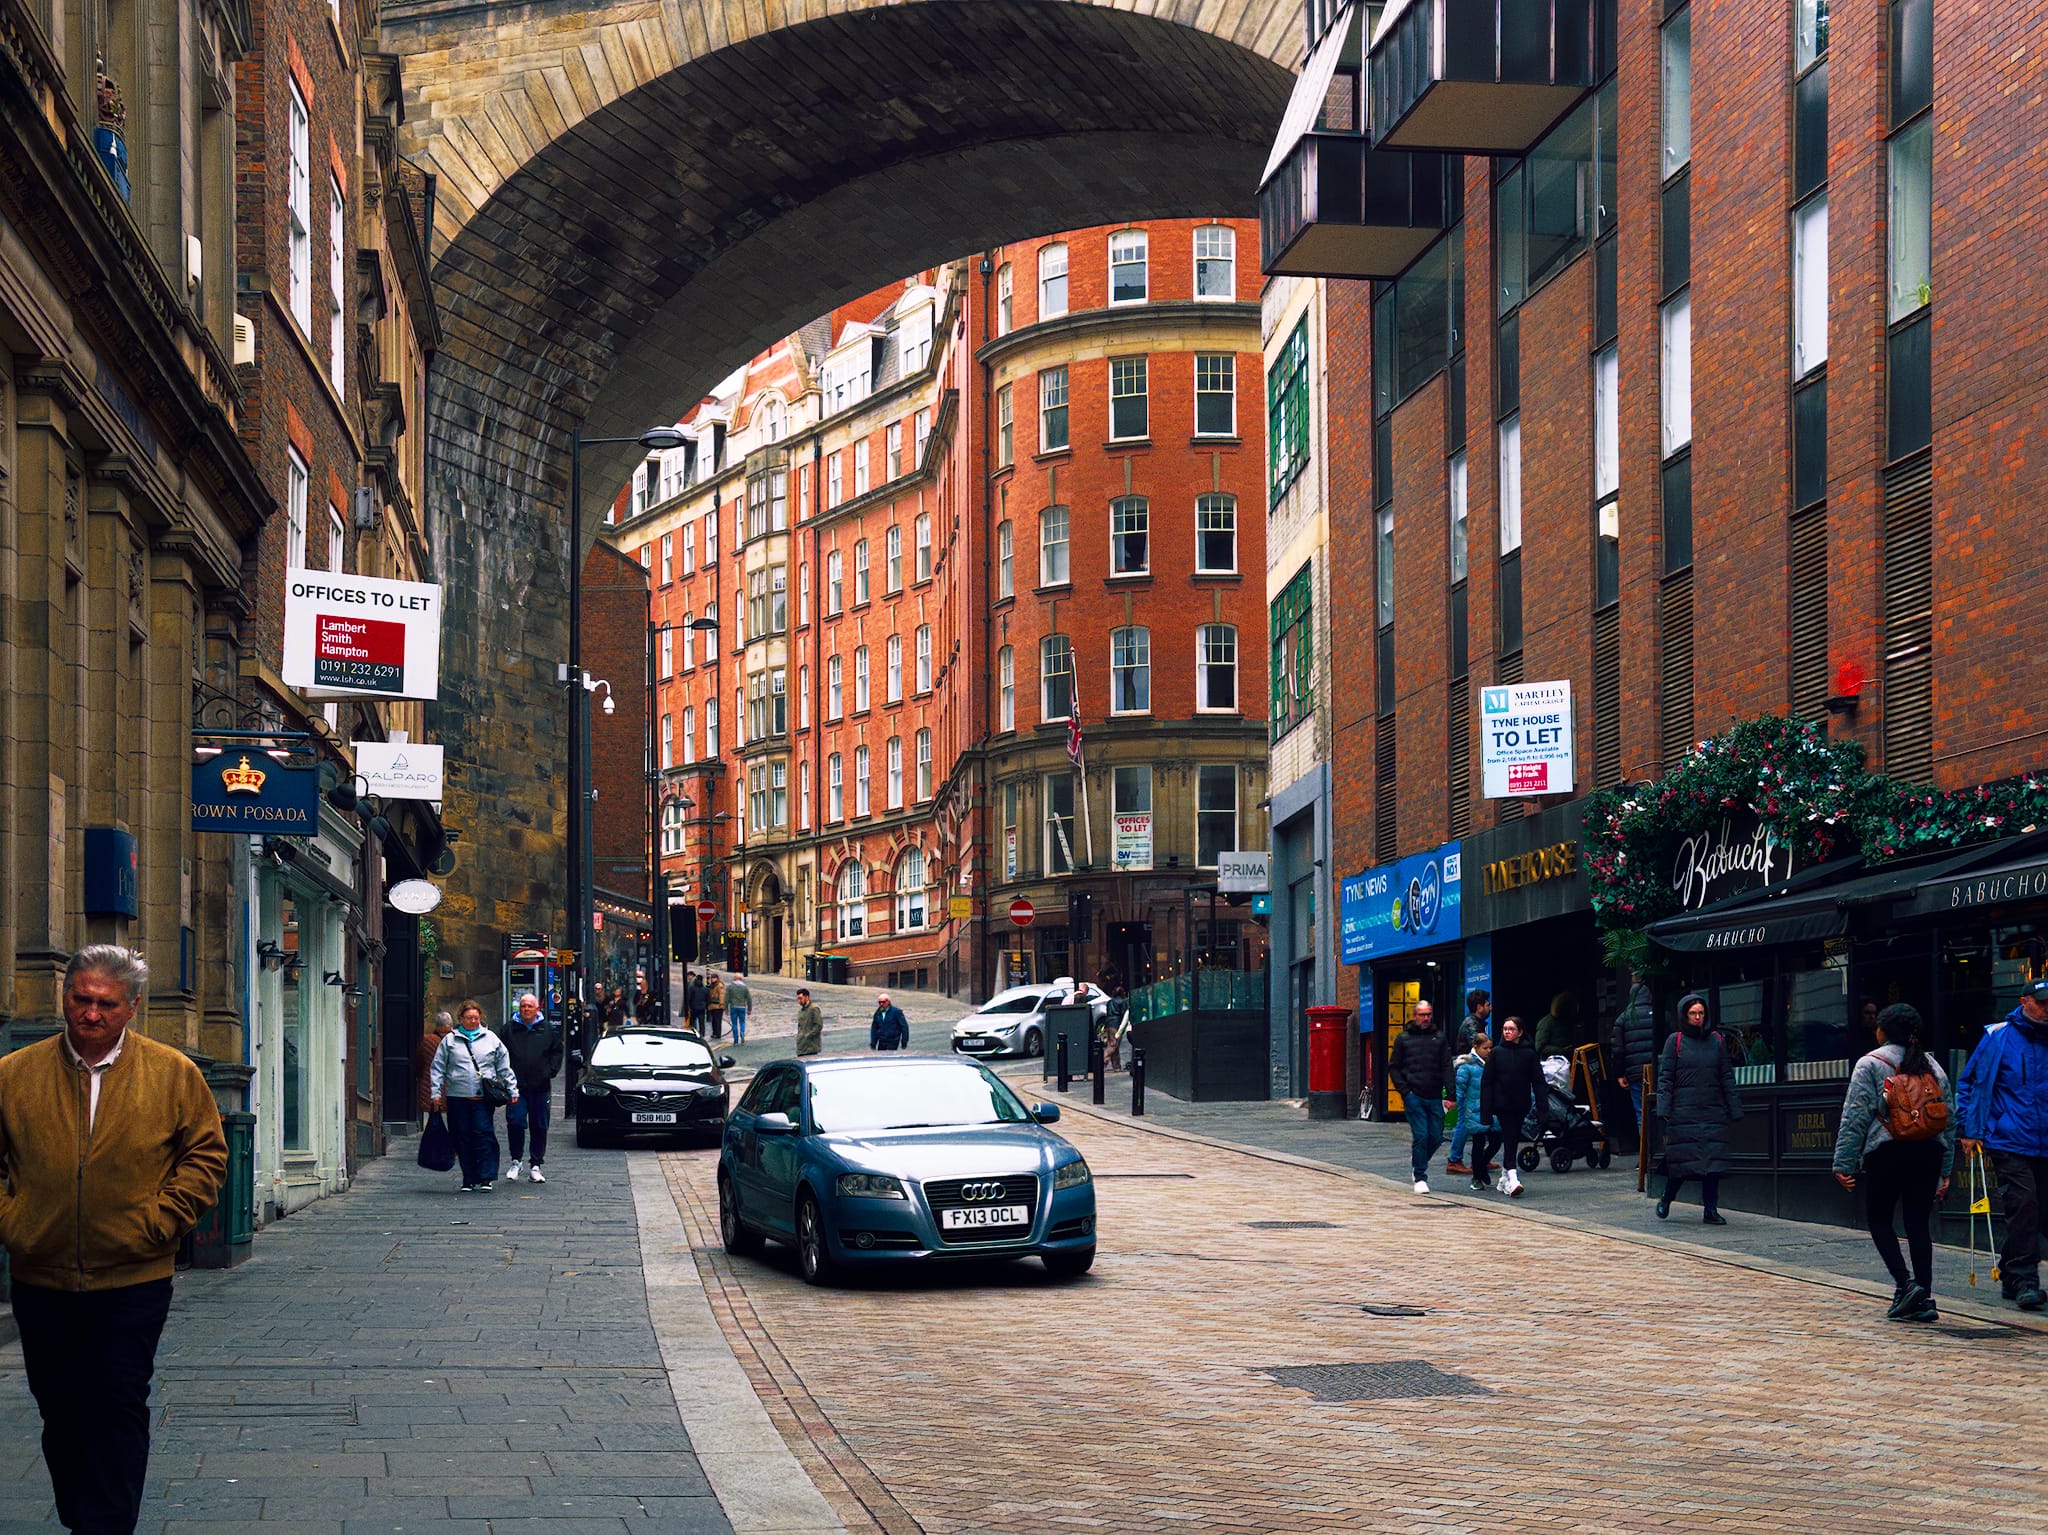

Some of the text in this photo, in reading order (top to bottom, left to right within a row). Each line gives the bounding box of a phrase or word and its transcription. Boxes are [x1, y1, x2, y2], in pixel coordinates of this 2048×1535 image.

[292, 583, 430, 611] OFFICES TO LET
[322, 619, 367, 634] Lambert
[321, 631, 352, 645] Smith
[321, 643, 369, 658] Hampton
[320, 660, 400, 678] 0191 232 6291
[319, 674, 377, 686] www.lsh.co.uk
[1491, 714, 1560, 728] TYNE HOUSE
[1492, 727, 1562, 748] TO LET
[360, 770, 438, 783] SALPARO
[243, 805, 308, 822] POSADA
[1117, 815, 1151, 825] OFFICES
[1120, 823, 1148, 833] TO LET
[1223, 863, 1266, 876] PRIMA
[1345, 874, 1387, 904] TYNE NEWS
[1421, 879, 1436, 907] ZYN
[1951, 871, 2047, 907] BABUCHO
[1706, 926, 1766, 948] BABUCHO
[1797, 1113, 1826, 1128] BIRRA
[1791, 1132, 1832, 1148] MORETTI
[952, 1208, 1019, 1225] FX13 OCL
